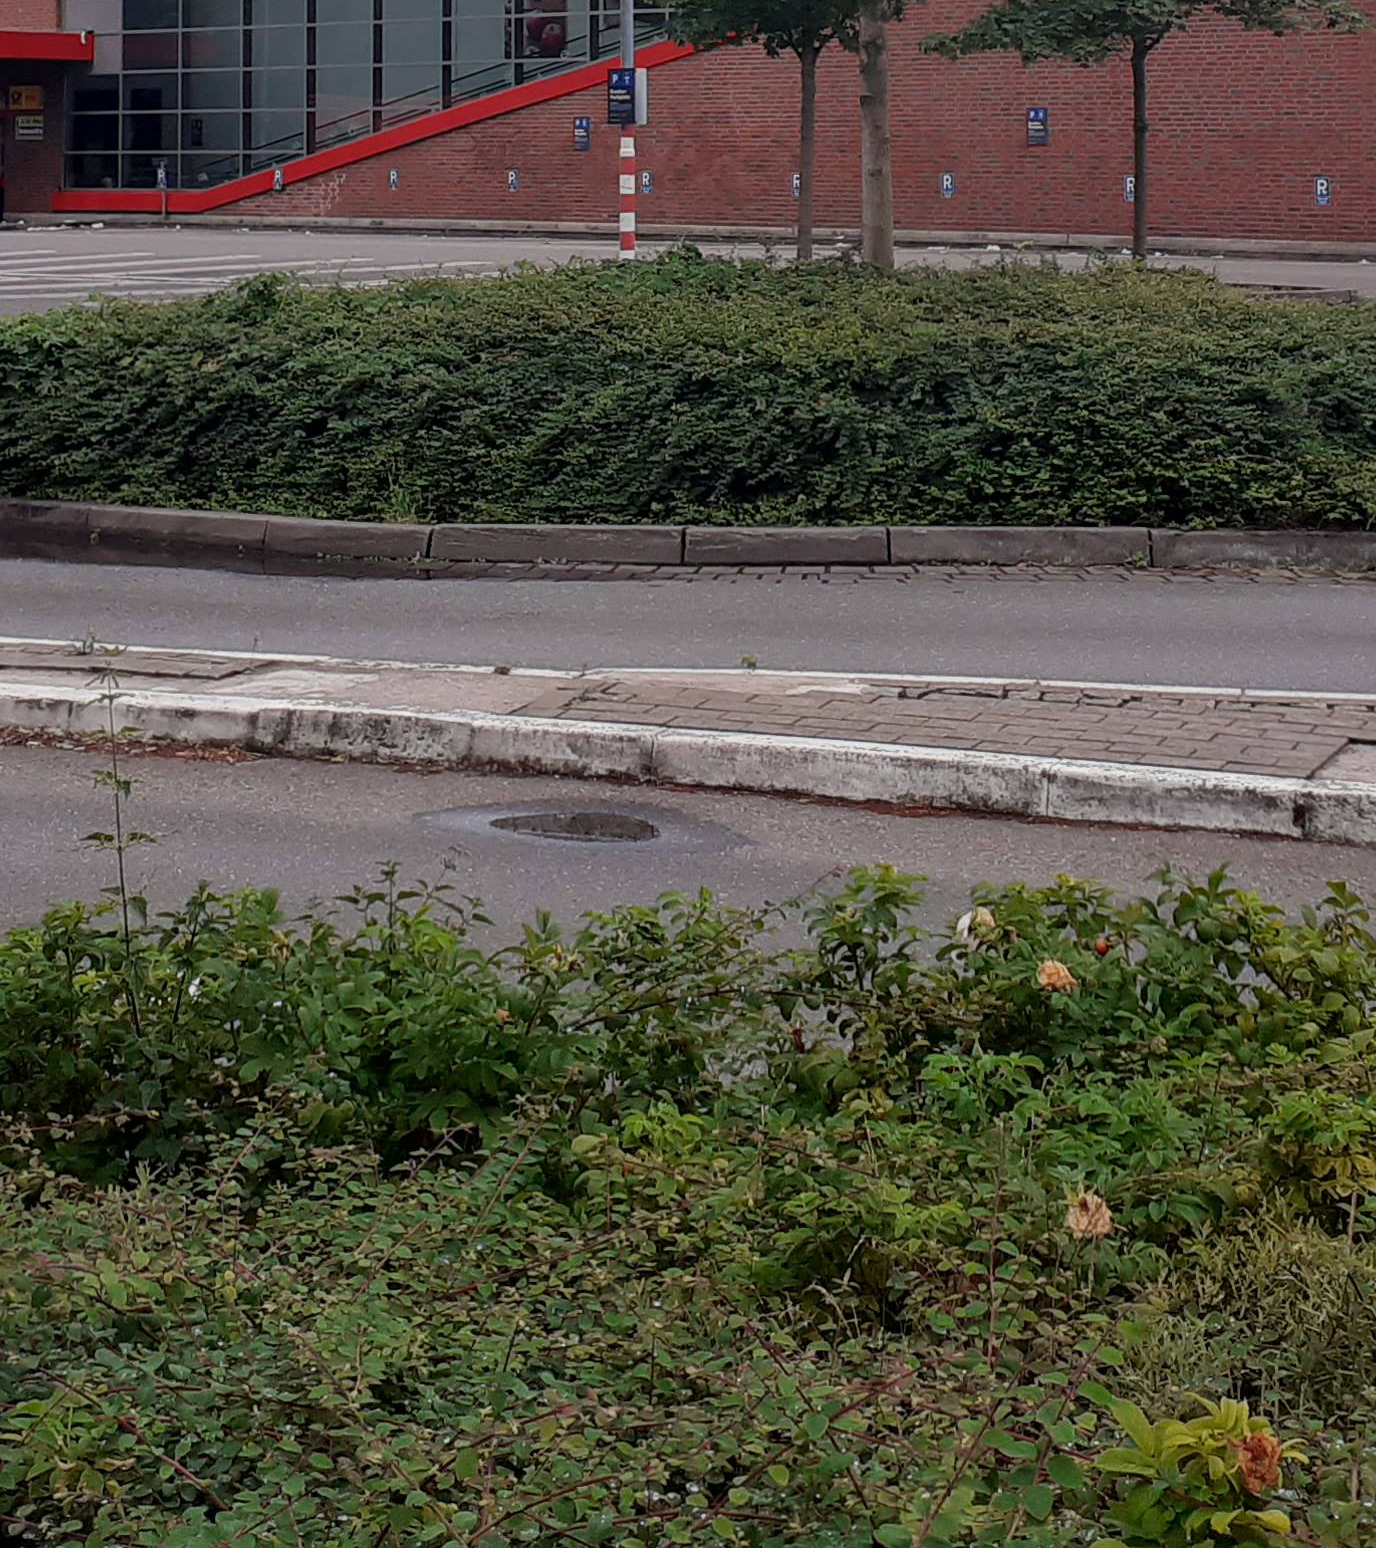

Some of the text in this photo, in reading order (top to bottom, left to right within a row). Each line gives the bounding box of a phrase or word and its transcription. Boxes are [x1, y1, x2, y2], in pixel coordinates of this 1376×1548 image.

[943, 175, 952, 189] R
[1126, 177, 1135, 192] R
[1317, 179, 1328, 195] R
